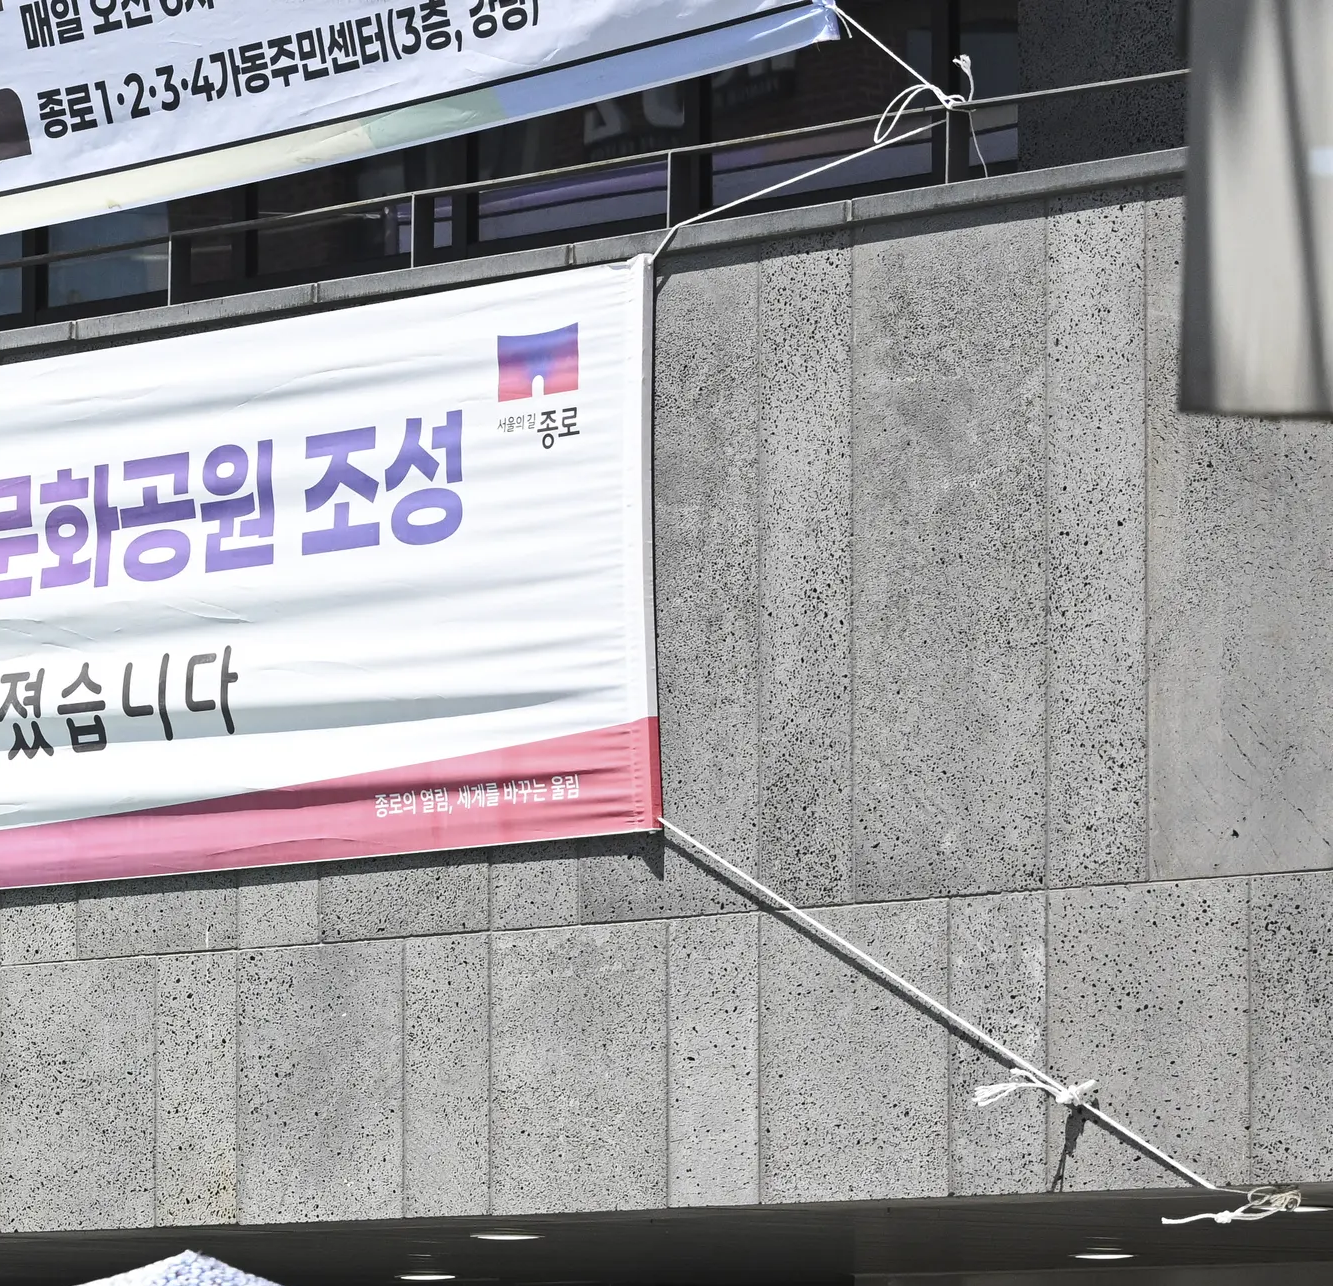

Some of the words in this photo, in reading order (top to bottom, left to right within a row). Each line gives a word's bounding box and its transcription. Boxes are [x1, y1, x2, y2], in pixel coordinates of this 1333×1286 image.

[497, 414, 525, 432] 서울의
[527, 413, 536, 429] 길
[536, 407, 580, 450] 종로
[301, 408, 466, 556] 조성
[374, 790, 416, 818] 종로의
[420, 787, 453, 815] 열림,
[457, 782, 500, 809] 세계를
[503, 779, 548, 806] 바꾸는
[551, 773, 580, 800] 울림
